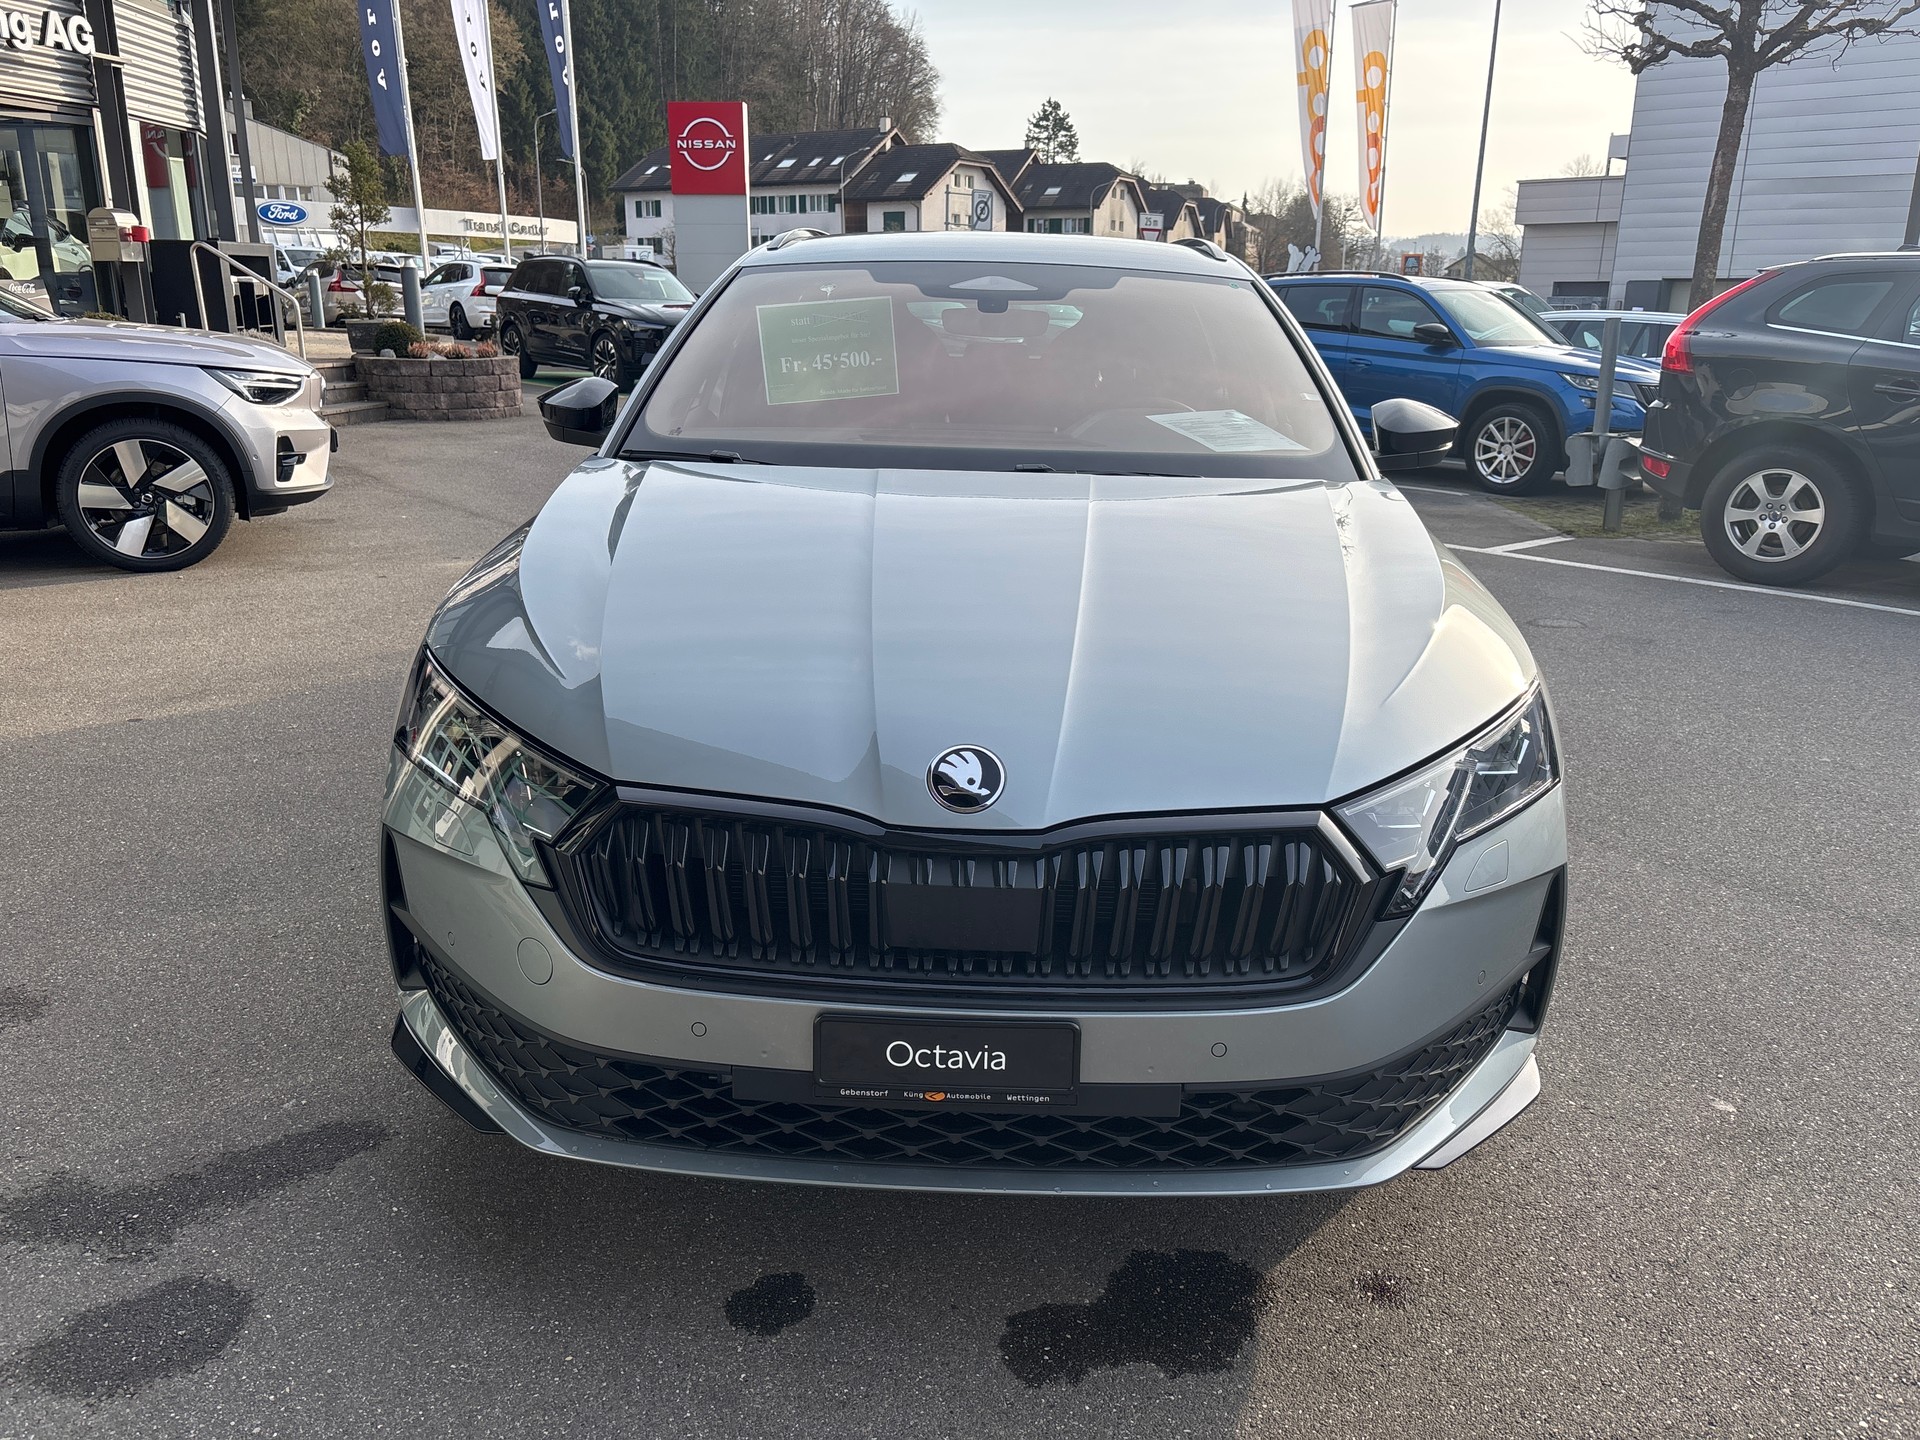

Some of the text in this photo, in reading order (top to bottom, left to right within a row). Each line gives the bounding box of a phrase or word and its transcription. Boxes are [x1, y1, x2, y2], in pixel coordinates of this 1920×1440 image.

[45, 10, 97, 55] AG
[676, 139, 736, 150] NISSAN
[268, 203, 299, 221] Ford
[790, 316, 810, 327] statt
[780, 350, 882, 374] Fr. 45'500.-
[885, 1040, 1007, 1071] Octavia
[840, 1088, 1050, 1103] Gebenstorf Küng Automobile Wettingen
